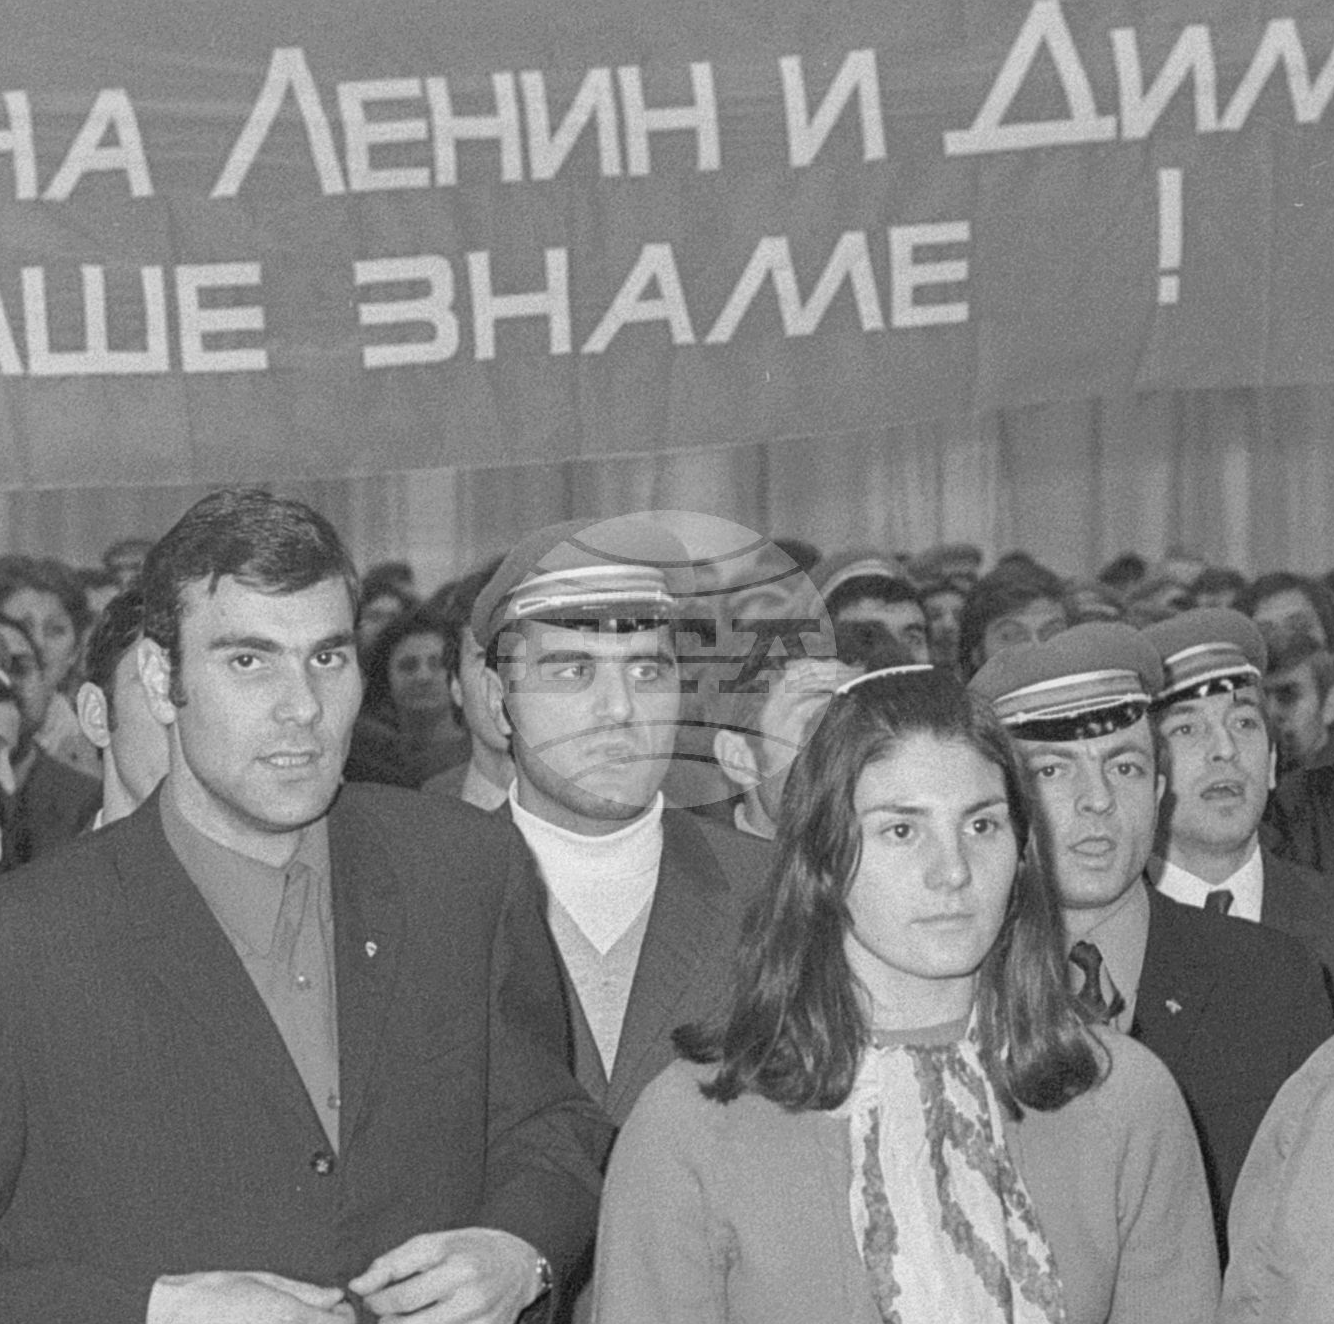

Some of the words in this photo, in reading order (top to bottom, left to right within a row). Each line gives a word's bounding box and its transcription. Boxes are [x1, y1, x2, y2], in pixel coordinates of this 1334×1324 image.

[209, 45, 721, 199] ЛЕНИН
[779, 47, 889, 169] И
[352, 220, 972, 371] ЗНАМЕ
